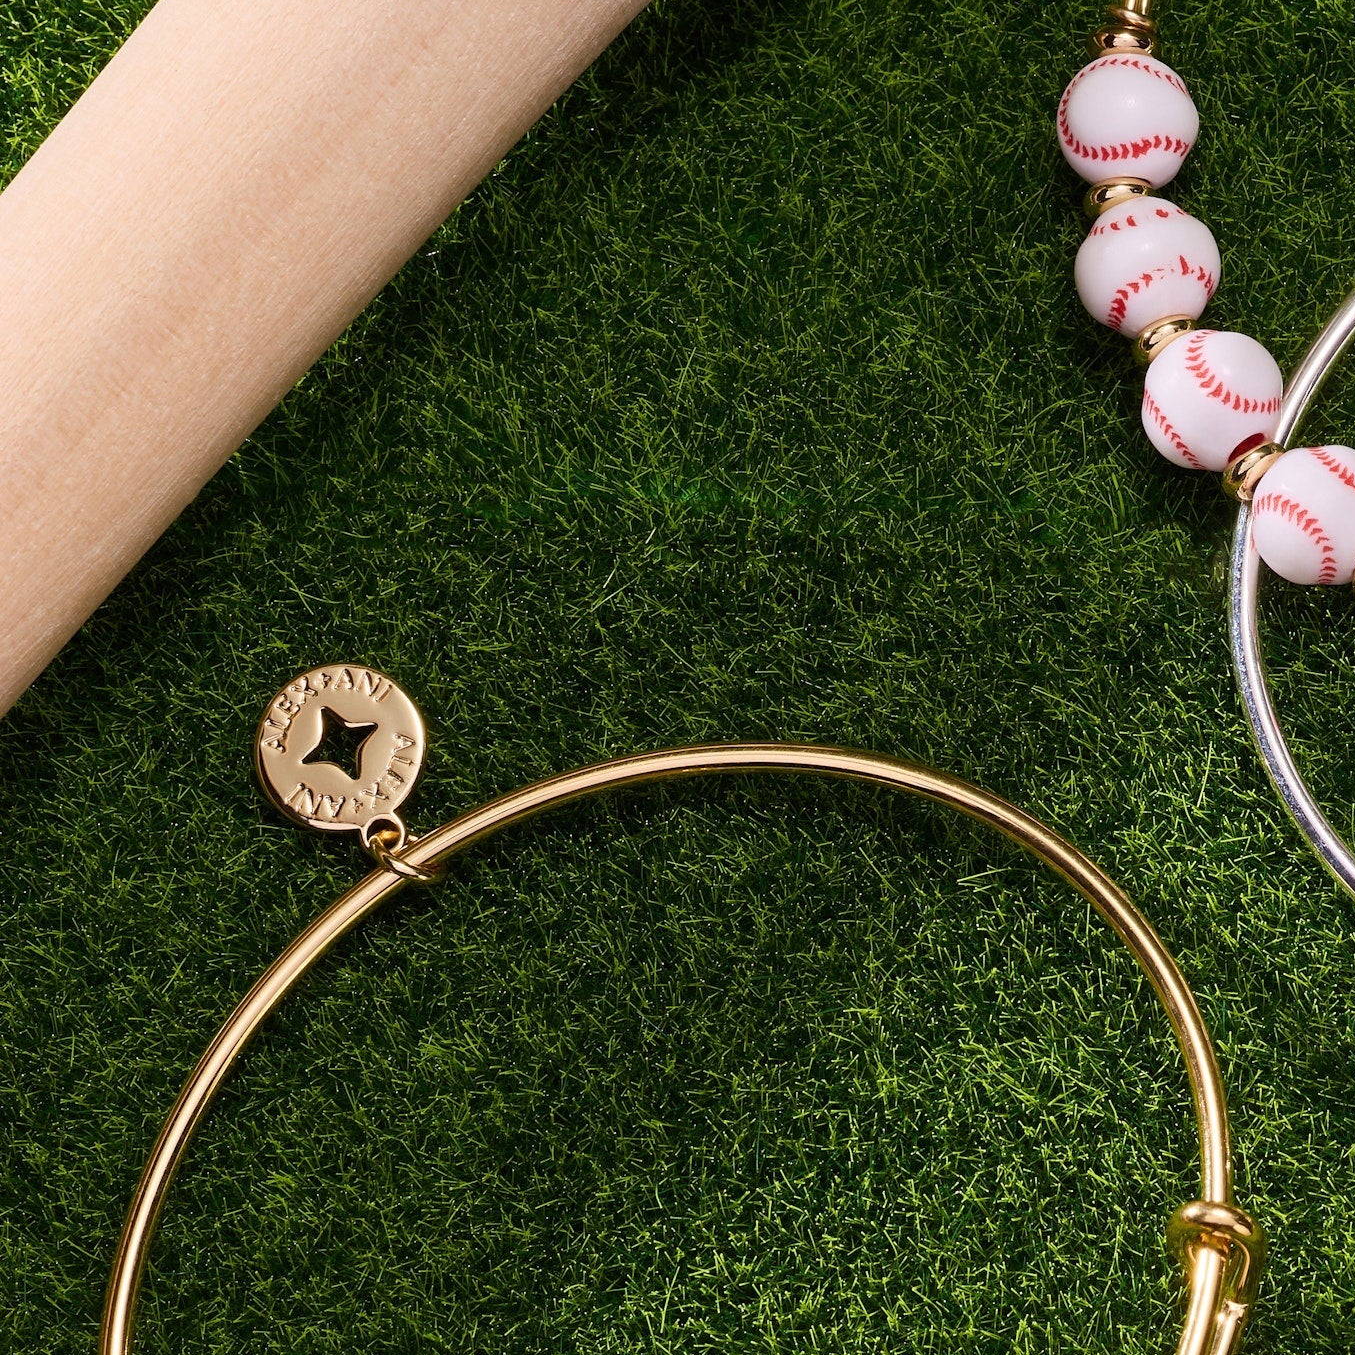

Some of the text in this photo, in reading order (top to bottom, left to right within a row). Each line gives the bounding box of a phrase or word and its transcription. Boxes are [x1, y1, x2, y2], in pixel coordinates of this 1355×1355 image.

[264, 677, 318, 752] ALEX
[332, 668, 393, 703] ANI
[286, 783, 346, 818] ANI
[361, 733, 416, 808] ALEX
